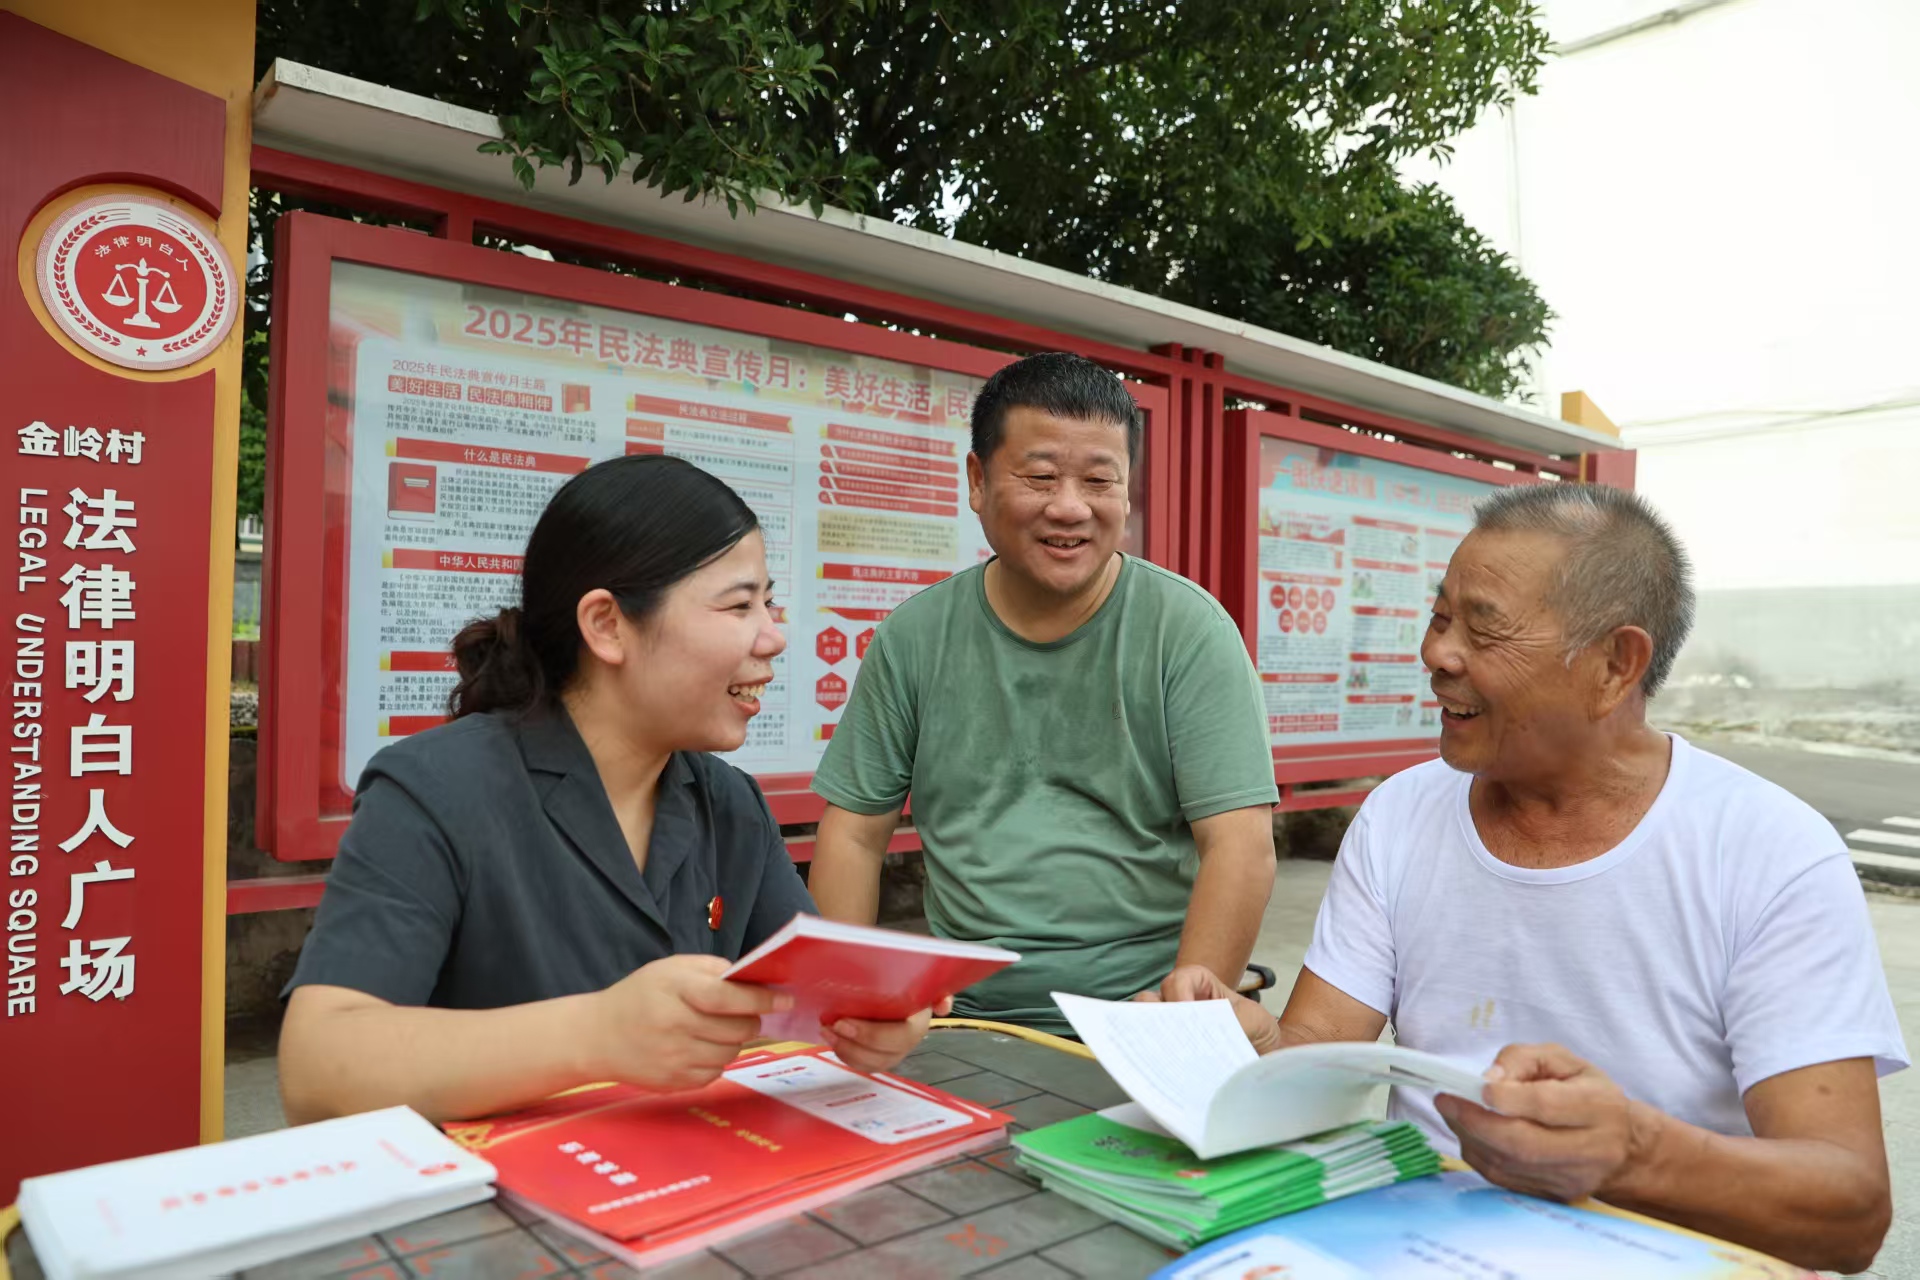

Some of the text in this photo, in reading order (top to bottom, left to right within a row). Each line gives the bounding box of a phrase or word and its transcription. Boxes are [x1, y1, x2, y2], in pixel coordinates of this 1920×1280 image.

[95, 235, 190, 272] 法律明白人
[389, 376, 461, 400] 美好生活
[17, 421, 146, 465] 金岭村
[463, 447, 537, 468] 什么是民法典
[7, 487, 48, 1017] LEGAL UNDERSTANDING SQUARE
[57, 486, 138, 1003] 法律明白人广场
